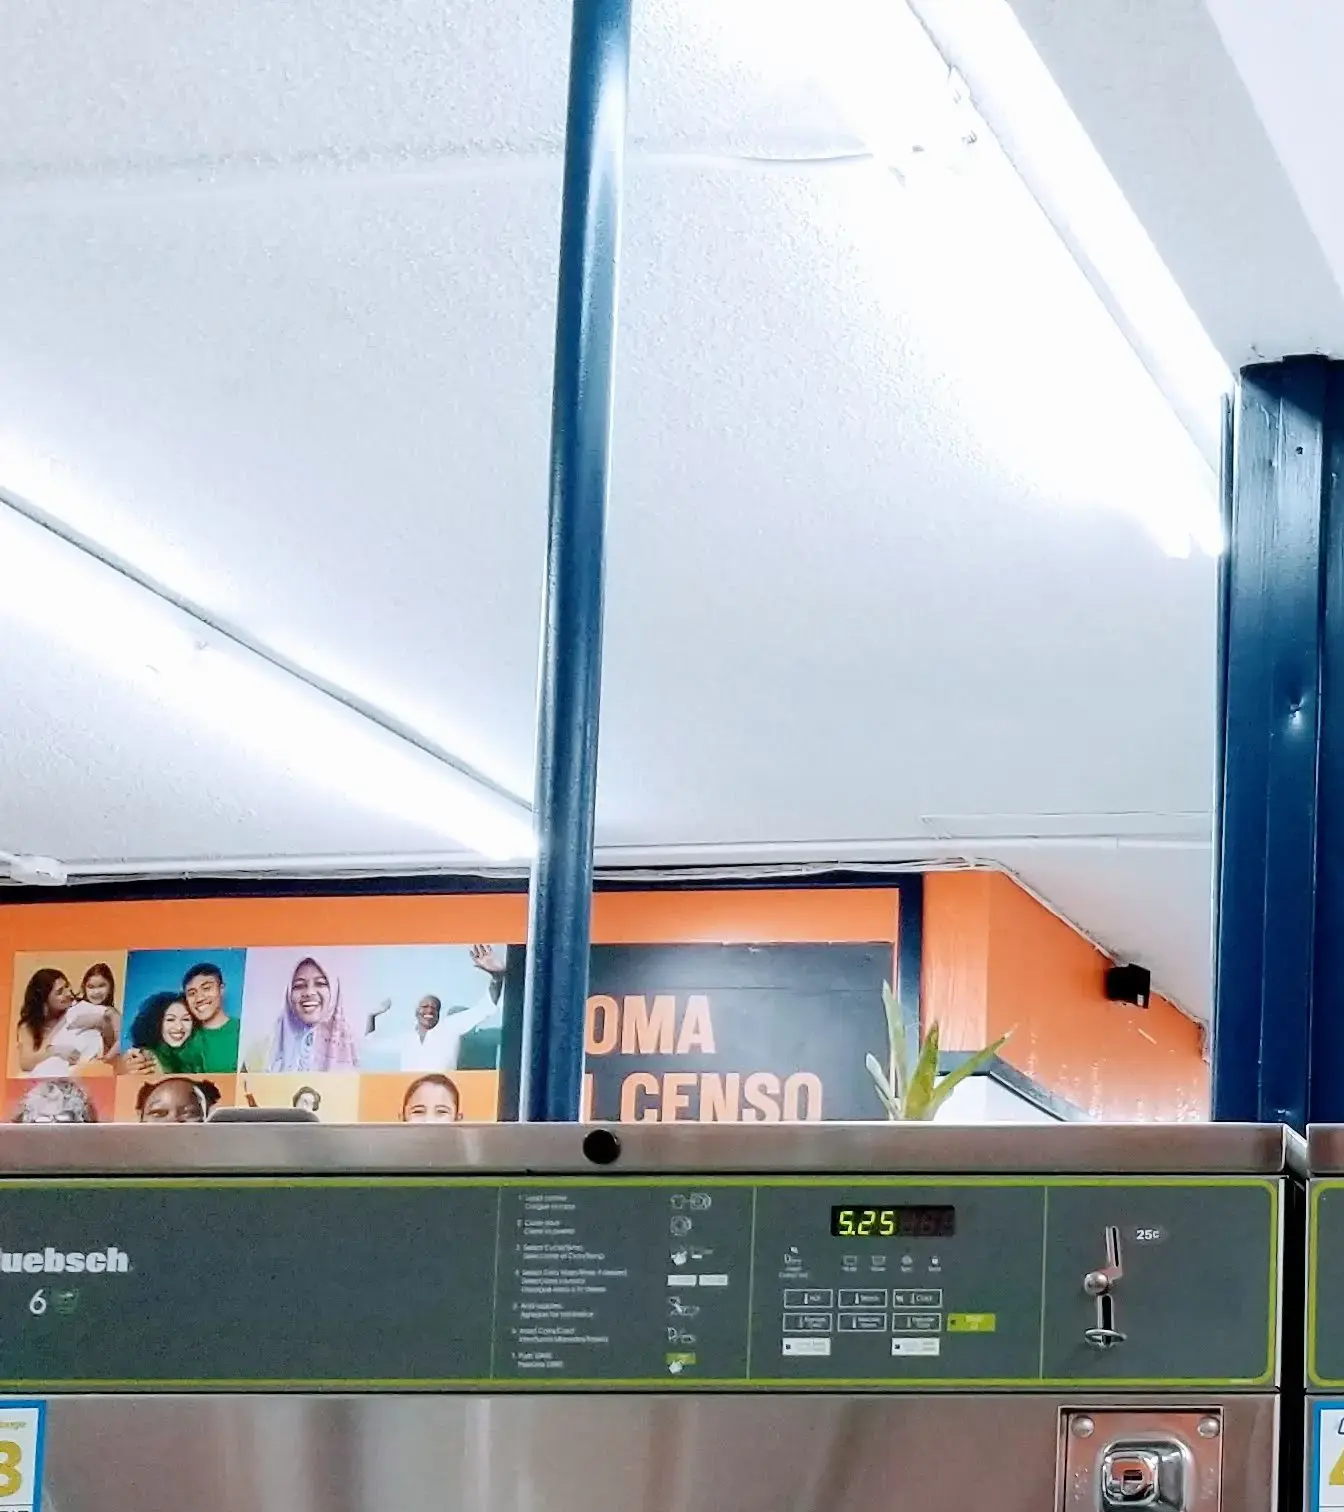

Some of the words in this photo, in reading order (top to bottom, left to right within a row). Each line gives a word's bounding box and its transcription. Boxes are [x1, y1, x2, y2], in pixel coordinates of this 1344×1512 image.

[585, 995, 717, 1055] OMA
[620, 1072, 824, 1122] CENSO
[838, 1209, 895, 1237] 5.25
[0, 1247, 129, 1273] uebsch
[29, 1288, 47, 1315] 6
